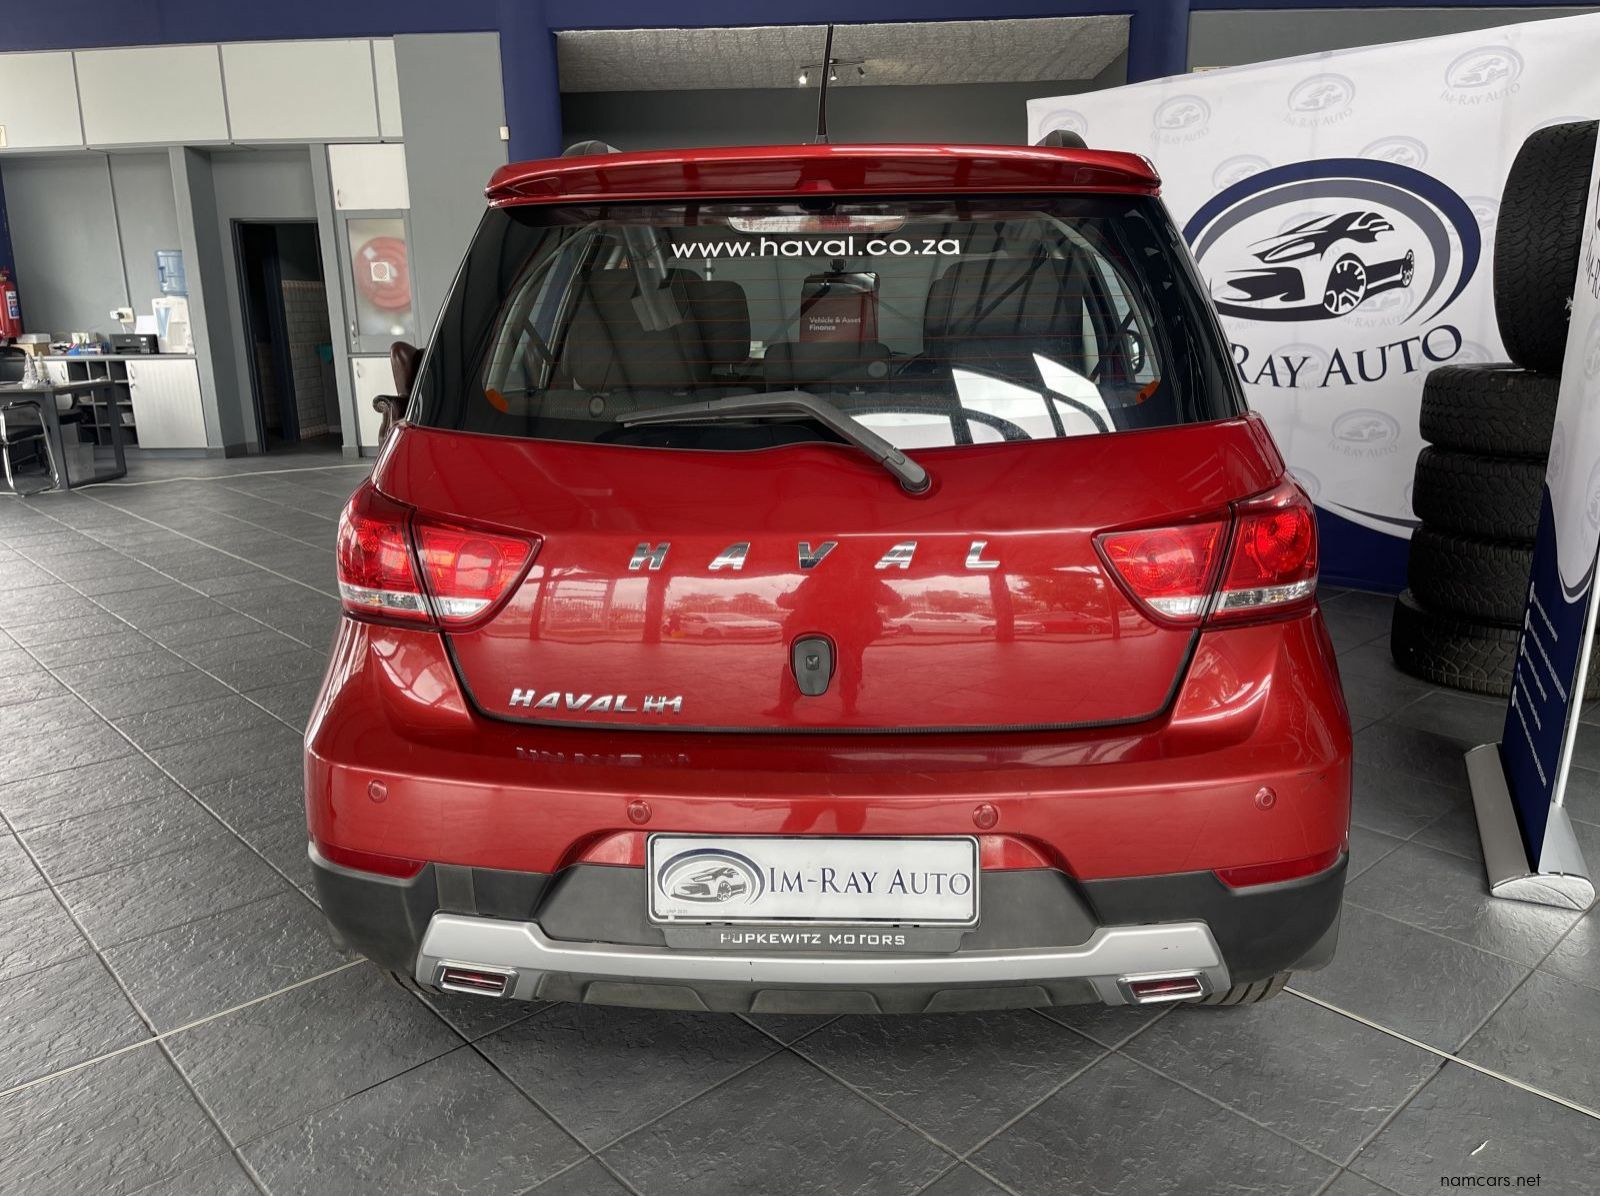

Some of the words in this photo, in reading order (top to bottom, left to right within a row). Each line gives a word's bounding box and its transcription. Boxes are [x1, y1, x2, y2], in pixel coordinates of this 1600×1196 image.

[671, 236, 961, 259] www.haval.co.za
[842, 316, 861, 324] Asset
[1230, 342, 1311, 388] RAY
[1317, 324, 1463, 388] AUTO
[627, 541, 1001, 571] HAVAL
[508, 688, 637, 712] HAVAL
[768, 867, 878, 893] IM-RAY
[888, 868, 971, 895] AUTO
[829, 933, 905, 946] MOTORS
